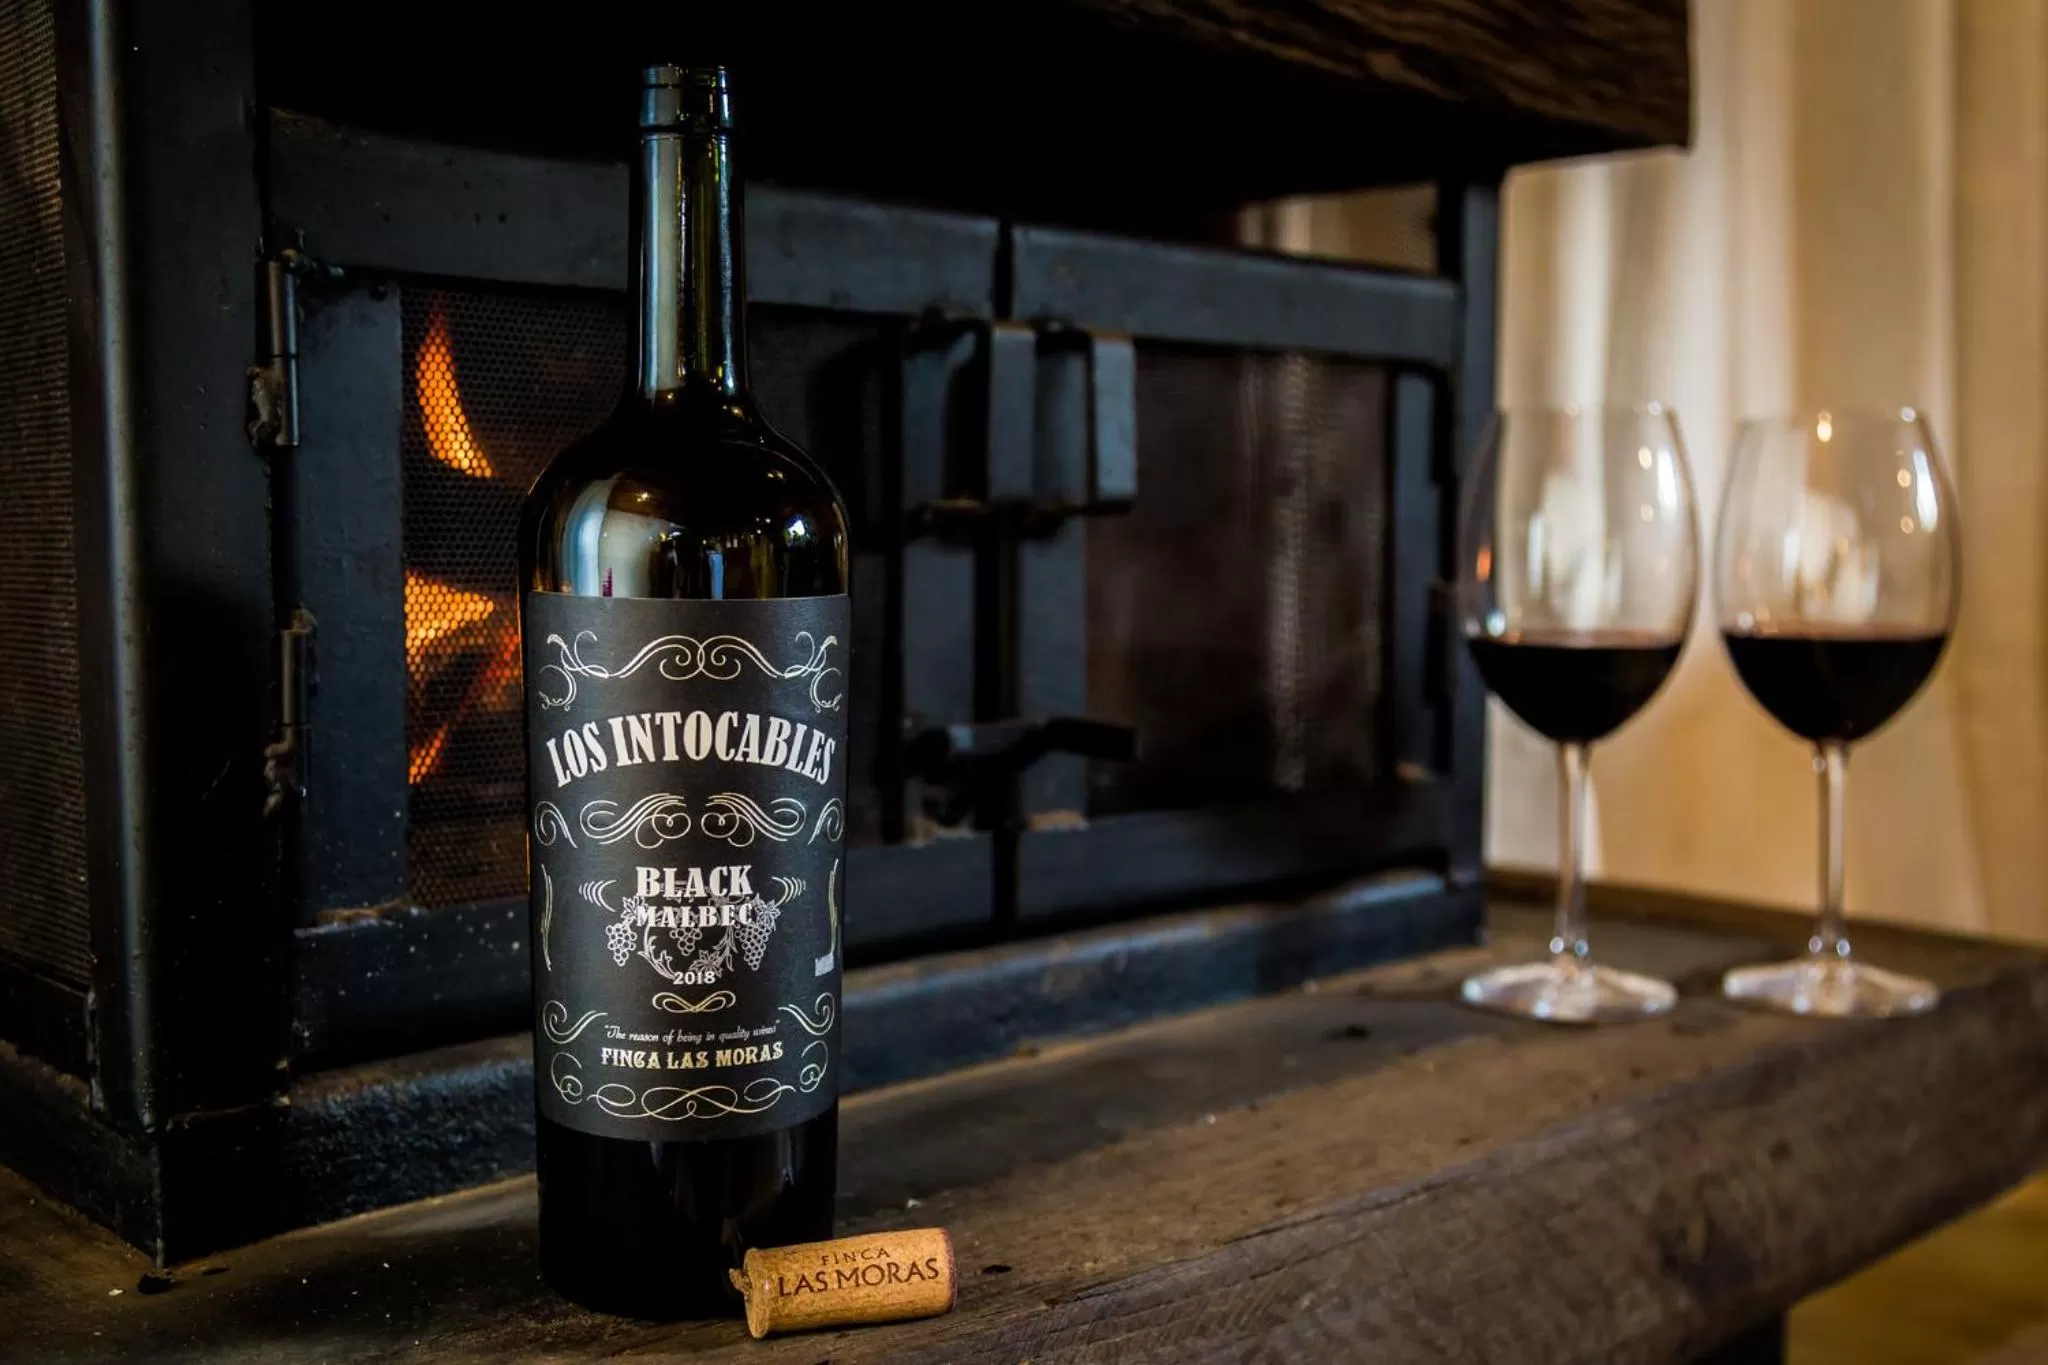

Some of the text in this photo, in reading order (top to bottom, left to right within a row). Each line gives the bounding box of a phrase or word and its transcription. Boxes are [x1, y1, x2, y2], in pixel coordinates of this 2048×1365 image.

[546, 710, 836, 788] LOS INTOCABLES
[636, 865, 753, 898] BLACK
[635, 903, 752, 928] MALBEC
[673, 971, 716, 985] 2018
[629, 1032, 659, 1042] reason
[662, 1029, 676, 1046] of
[676, 1029, 702, 1045] being
[706, 1031, 716, 1042] in
[719, 1025, 750, 1042] quality
[601, 1041, 784, 1069] FINCA LAS MORAS
[821, 1247, 891, 1266] FINCA
[778, 1257, 940, 1298] LAS MORAS
